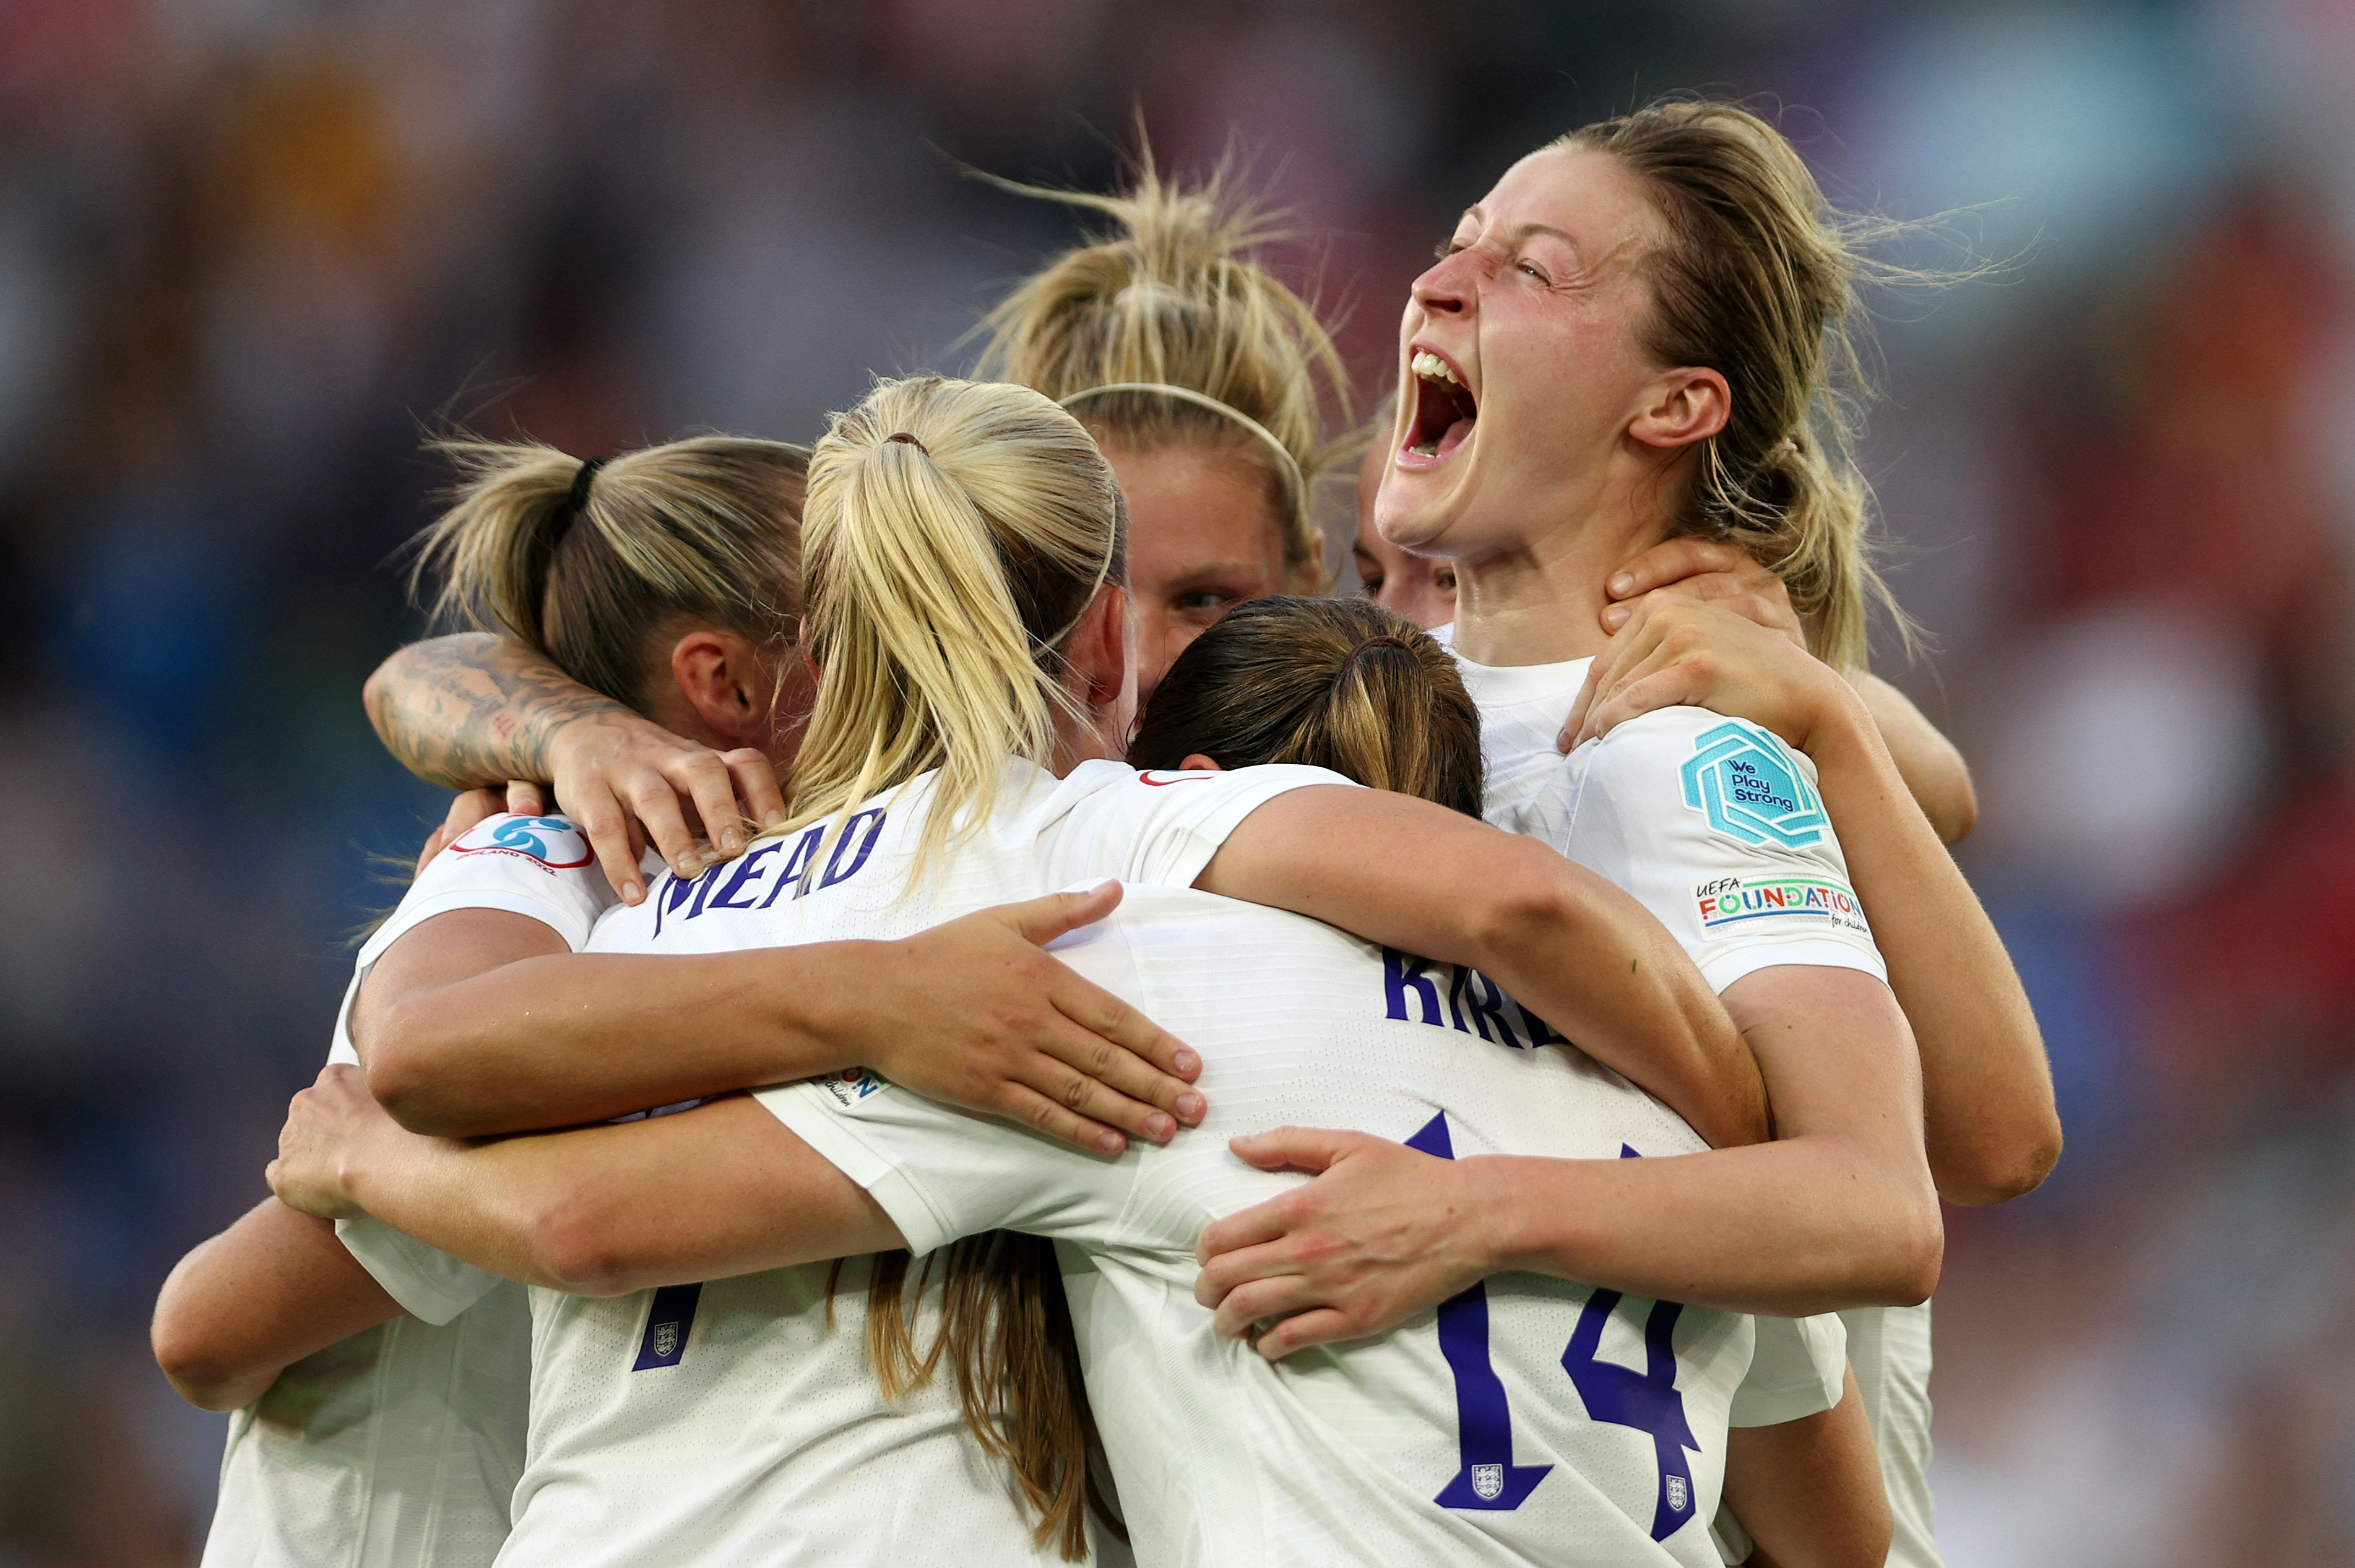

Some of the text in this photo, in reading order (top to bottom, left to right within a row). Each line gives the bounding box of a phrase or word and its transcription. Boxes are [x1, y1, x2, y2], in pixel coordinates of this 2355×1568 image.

[1727, 759, 1756, 774] We
[1732, 775, 1770, 793] Play
[1735, 788, 1794, 812] Strong
[525, 857, 558, 877] 2022
[652, 807, 887, 941] MEAD
[1697, 877, 1740, 897] UEFA
[1699, 887, 1863, 919] FOUNDATION
[1831, 913, 1842, 928] for
[825, 1081, 850, 1106] children
[1402, 1108, 1703, 1543] 14
